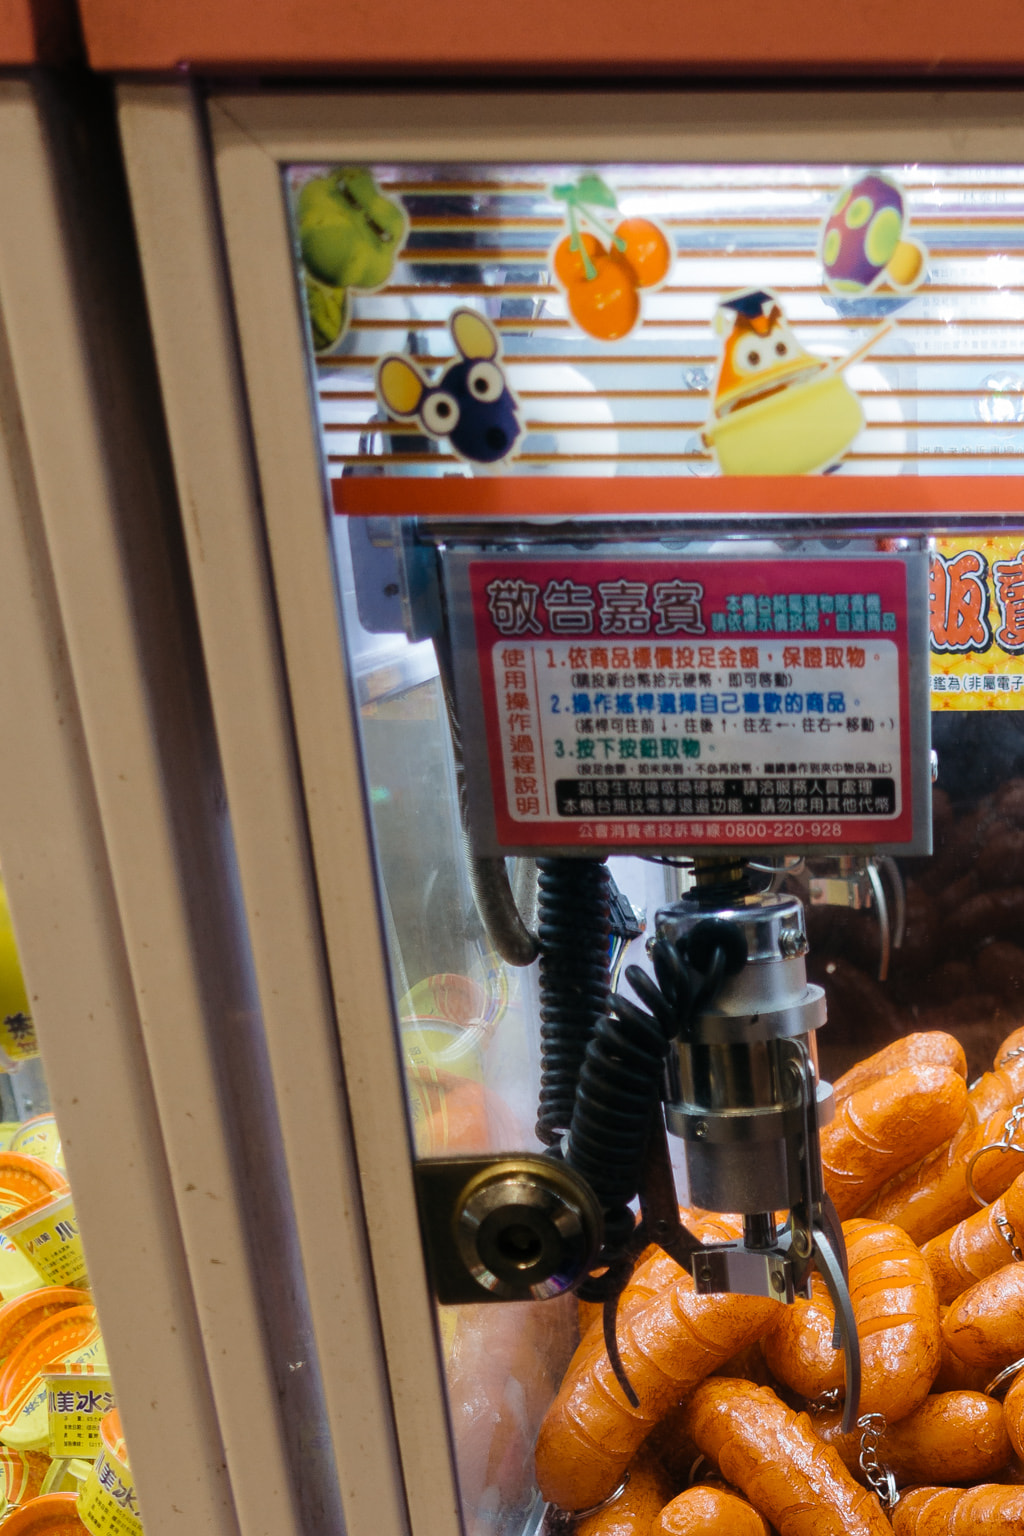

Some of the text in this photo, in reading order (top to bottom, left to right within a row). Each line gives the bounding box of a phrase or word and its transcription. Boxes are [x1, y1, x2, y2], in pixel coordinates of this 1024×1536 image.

[487, 578, 706, 635] 敬告嘉賓
[501, 648, 540, 816] 使用操作過程說明
[724, 823, 842, 838] 0800-220-928
